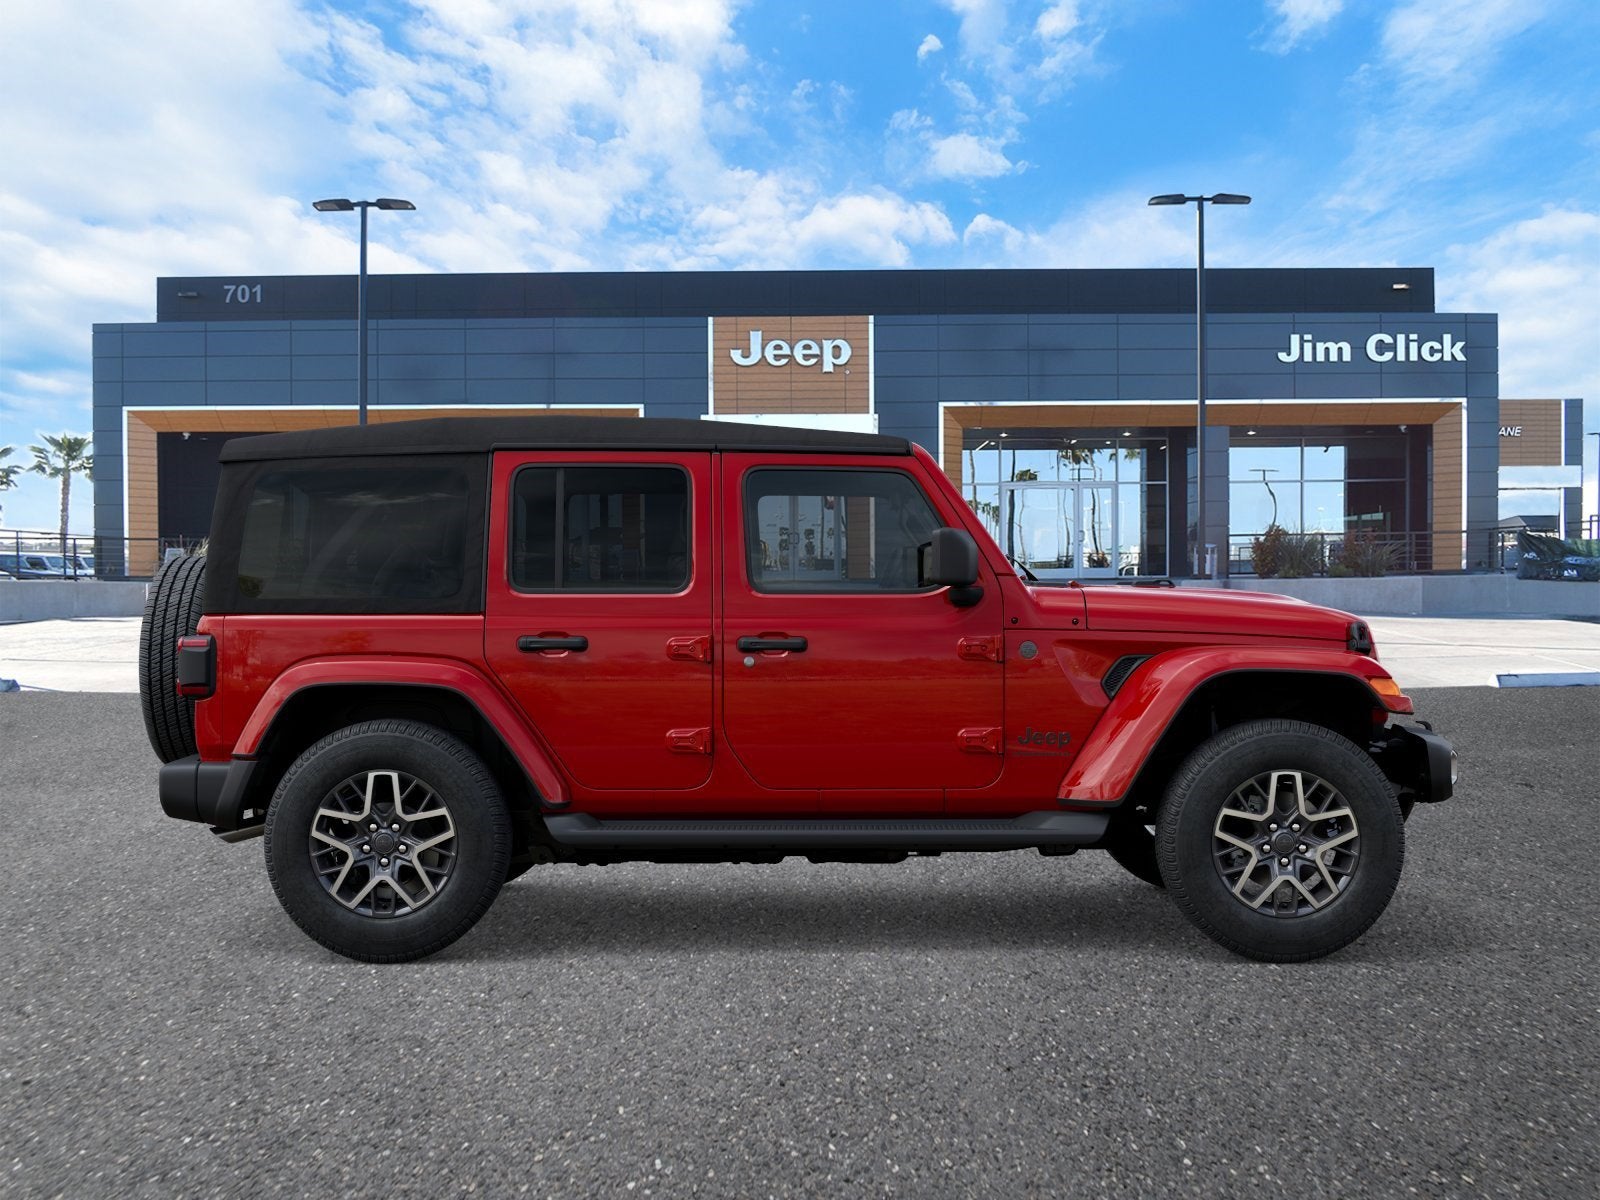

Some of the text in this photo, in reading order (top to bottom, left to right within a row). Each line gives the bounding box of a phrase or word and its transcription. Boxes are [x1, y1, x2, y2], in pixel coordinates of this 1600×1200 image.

[223, 284, 262, 304] 701
[729, 329, 852, 374] Jeep
[1277, 333, 1467, 363] Jim Click
[1017, 726, 1071, 749] Jeep
